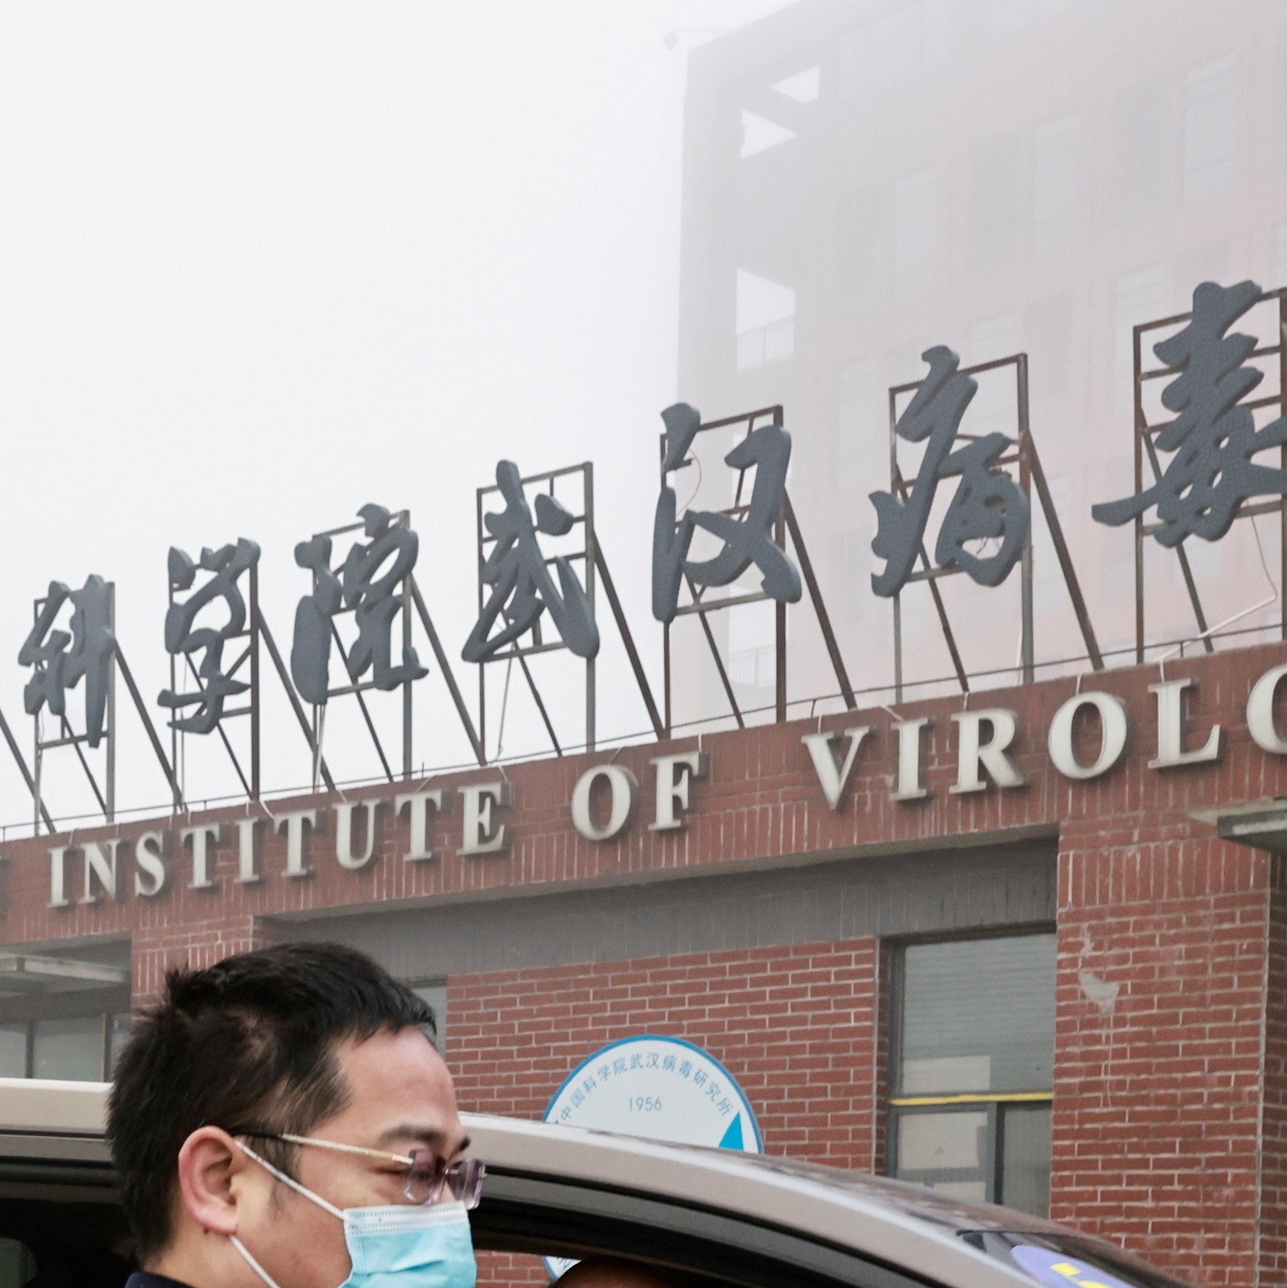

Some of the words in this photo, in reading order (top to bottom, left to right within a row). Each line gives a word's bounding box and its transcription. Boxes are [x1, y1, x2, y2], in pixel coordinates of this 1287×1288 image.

[47, 780, 512, 909] INSTITUTE
[571, 750, 704, 841] OF
[560, 1051, 734, 1123] 中国科学院武汉病毒研究所
[627, 1096, 663, 1112] 1956
